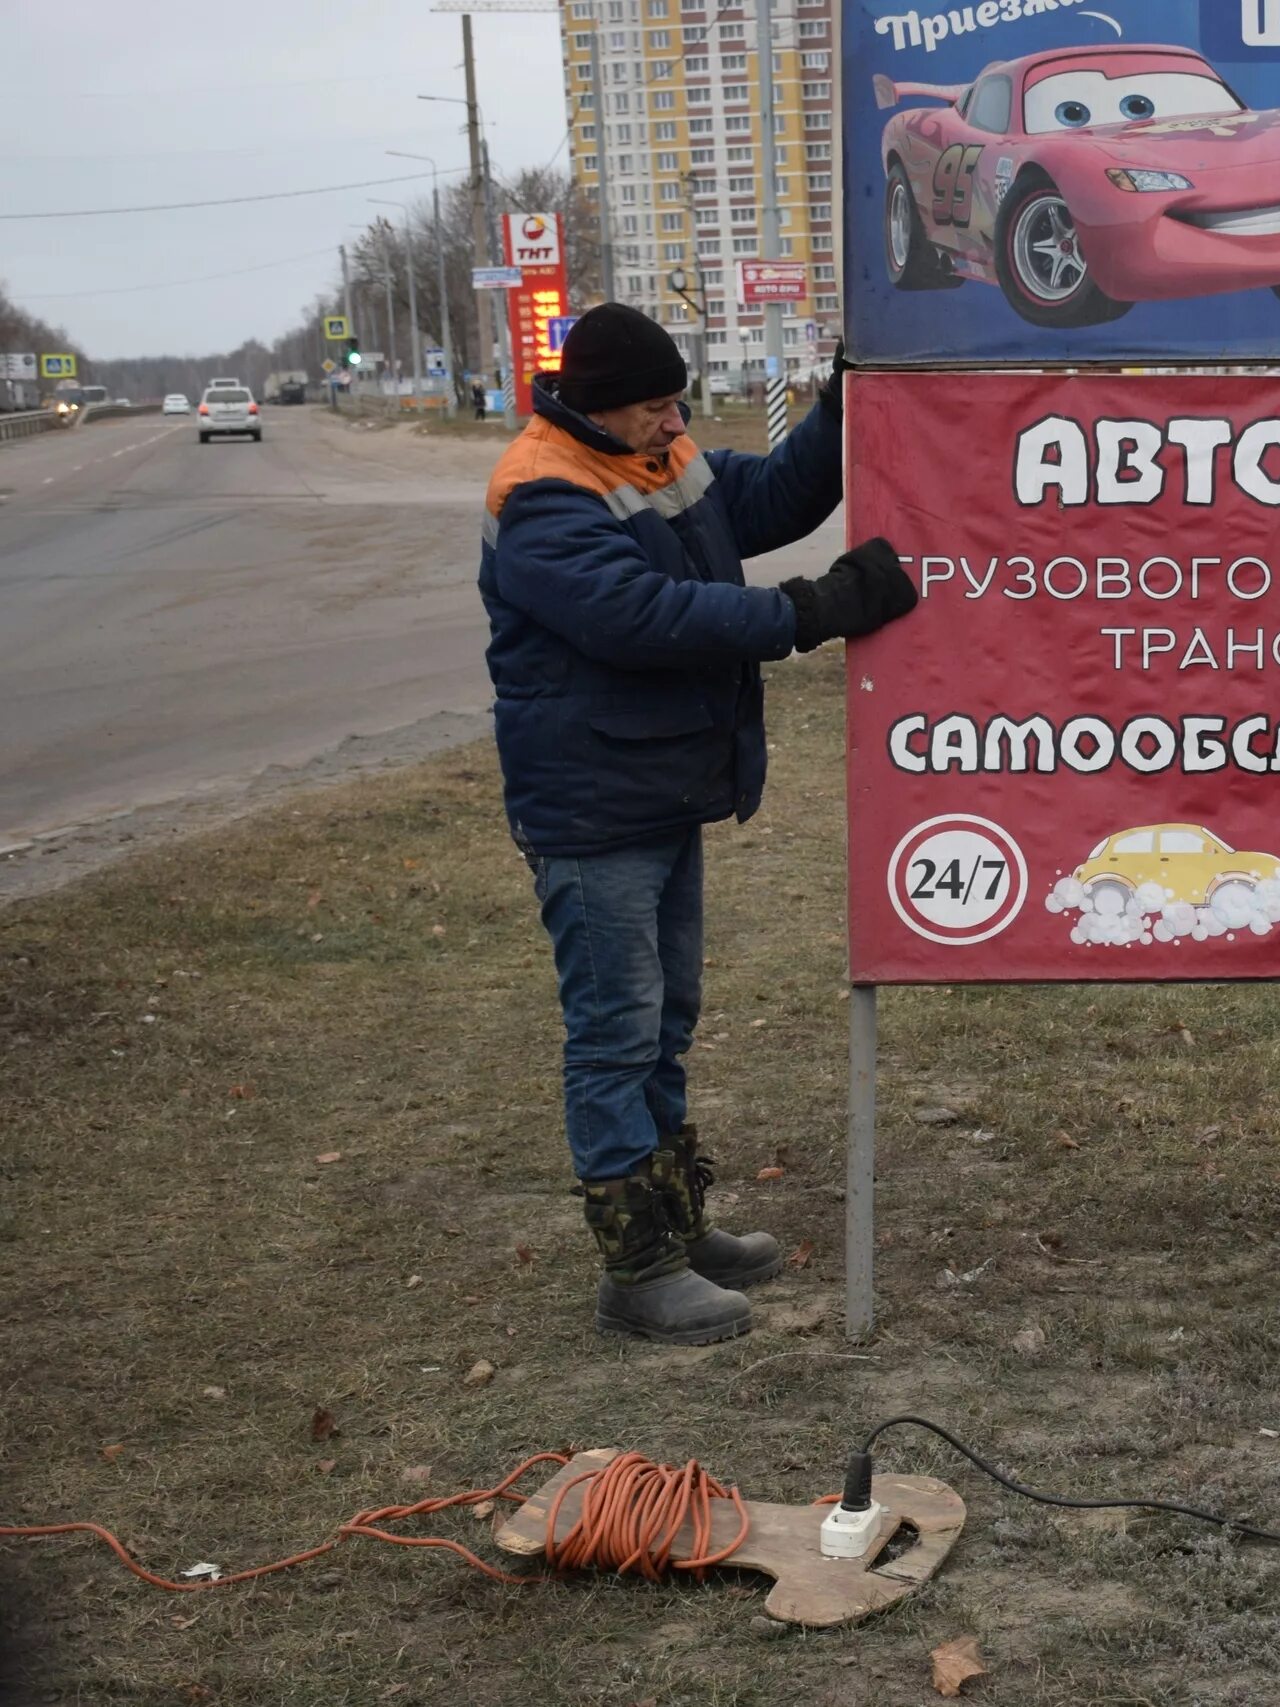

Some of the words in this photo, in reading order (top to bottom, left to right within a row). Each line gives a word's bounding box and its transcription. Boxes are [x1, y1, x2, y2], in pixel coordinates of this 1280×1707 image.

[874, 0, 1085, 52] Приезж
[932, 142, 986, 229] 95
[517, 247, 554, 260] ТНТ
[898, 555, 1273, 600] РУЗОВОГО
[910, 854, 1007, 906] 24/7
